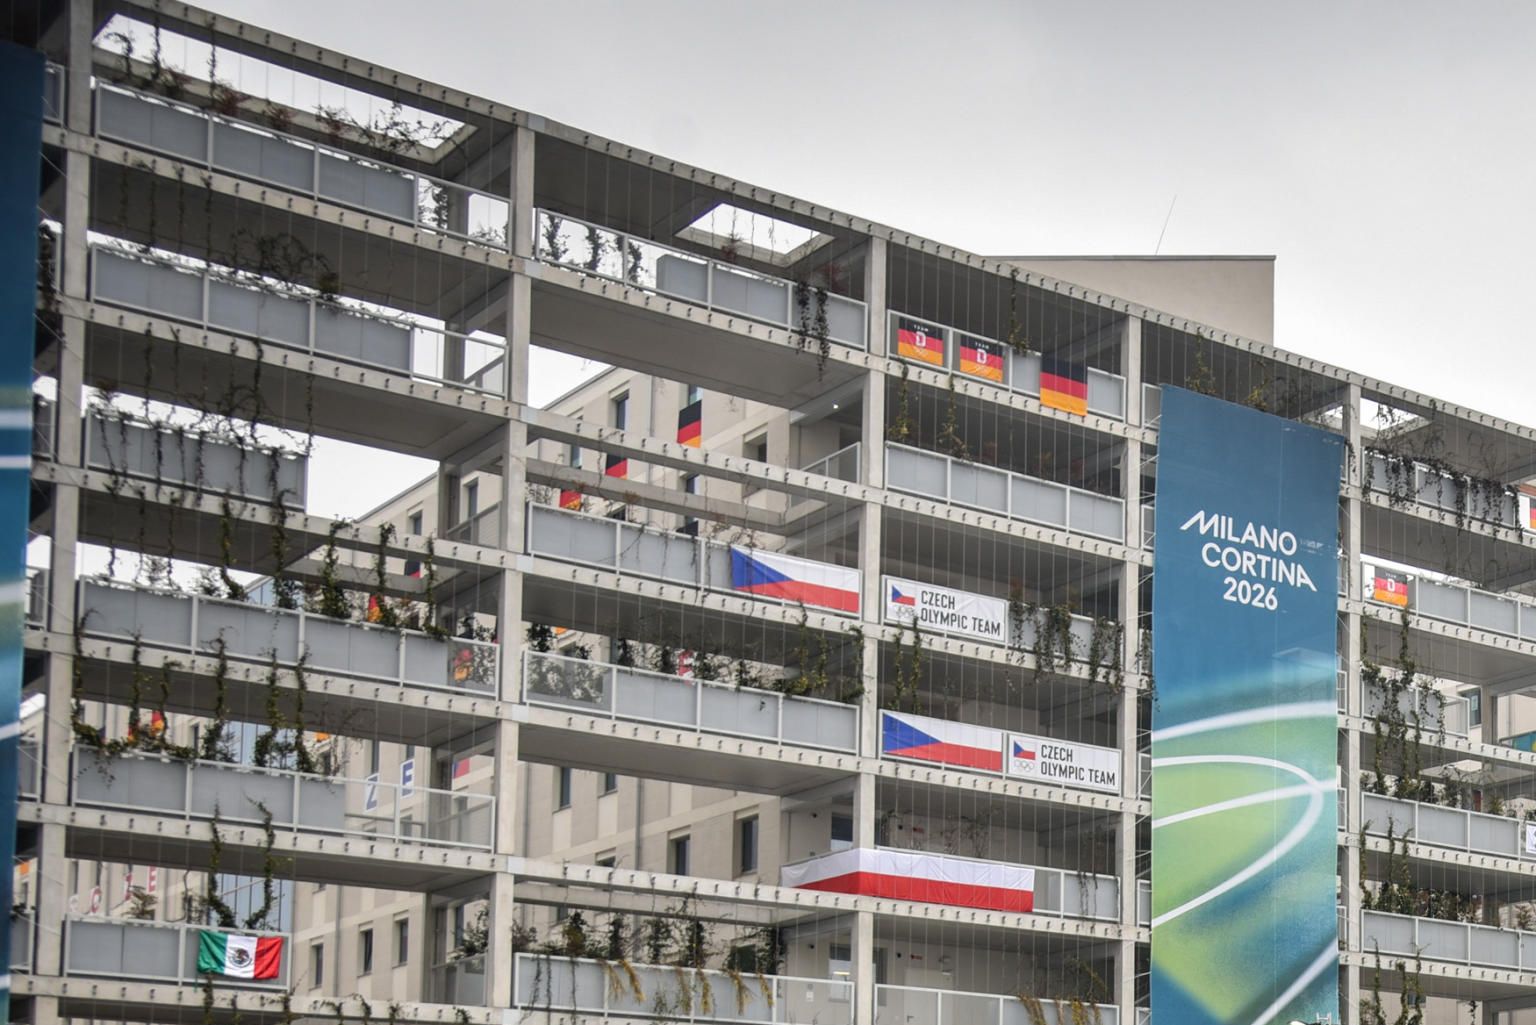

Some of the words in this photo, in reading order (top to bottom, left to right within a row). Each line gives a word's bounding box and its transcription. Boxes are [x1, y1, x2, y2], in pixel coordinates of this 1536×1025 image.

[1179, 510, 1297, 556] MILANO
[1202, 542, 1317, 592] CORTINA
[921, 590, 955, 610] CZECH
[1223, 576, 1278, 611] 2026
[920, 607, 968, 629] OLYMPIC
[972, 616, 1001, 636] TEAM
[1041, 744, 1073, 762] CZECH
[1040, 762, 1085, 780] OLYMPIC
[1088, 768, 1116, 786] TEAM
